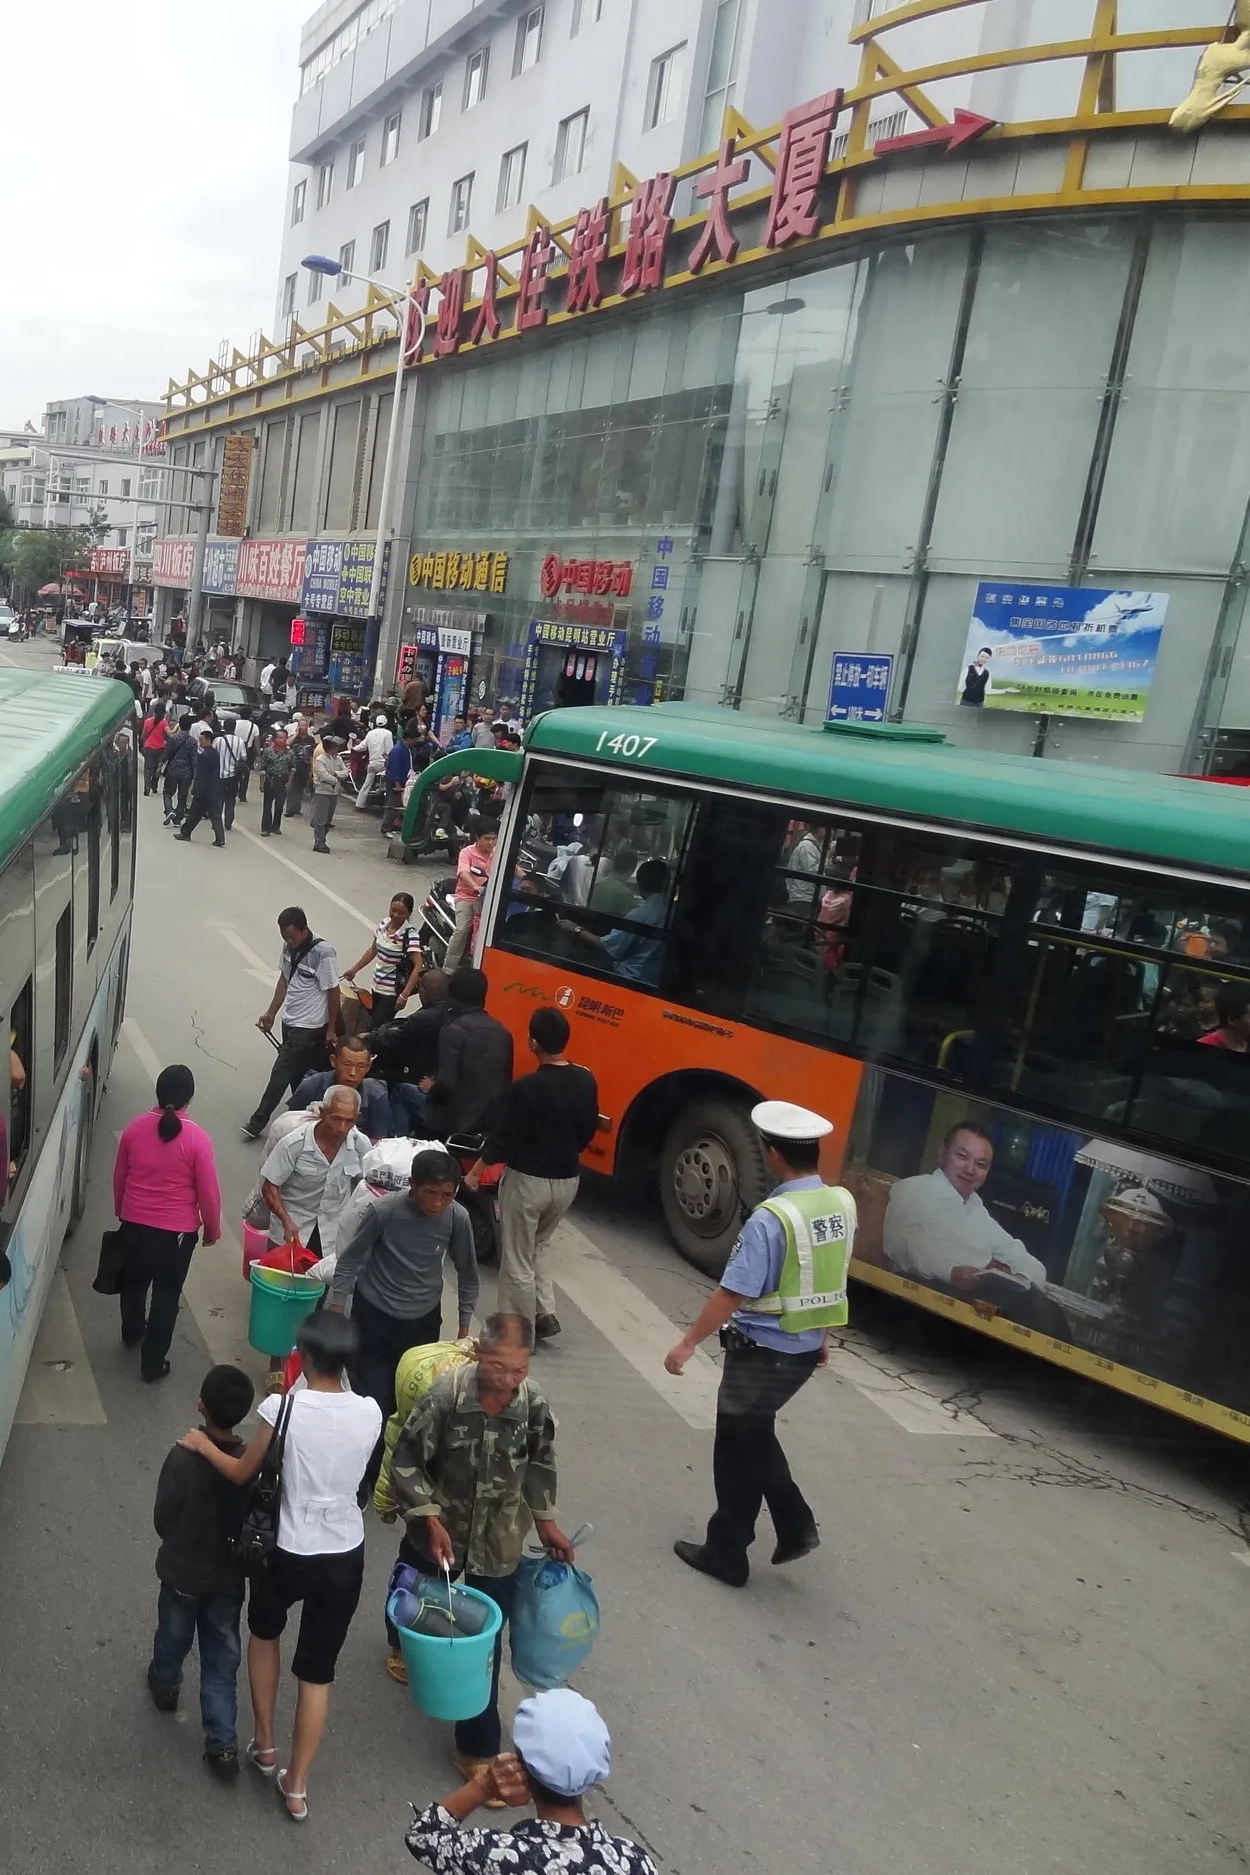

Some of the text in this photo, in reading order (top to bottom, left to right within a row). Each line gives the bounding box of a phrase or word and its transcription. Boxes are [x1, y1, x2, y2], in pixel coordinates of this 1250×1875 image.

[237, 541, 308, 586] 川味百姓餐厅
[313, 544, 342, 573] 中国移动
[421, 551, 509, 594] 中国移动通信
[561, 559, 634, 597] 中国移动
[416, 629, 437, 646] 中国移动
[535, 622, 617, 648] 中国移动昆明站营业厅
[595, 730, 659, 759] 1407
[577, 995, 626, 1021] 昆明新巴
[811, 1214, 844, 1243] 警察
